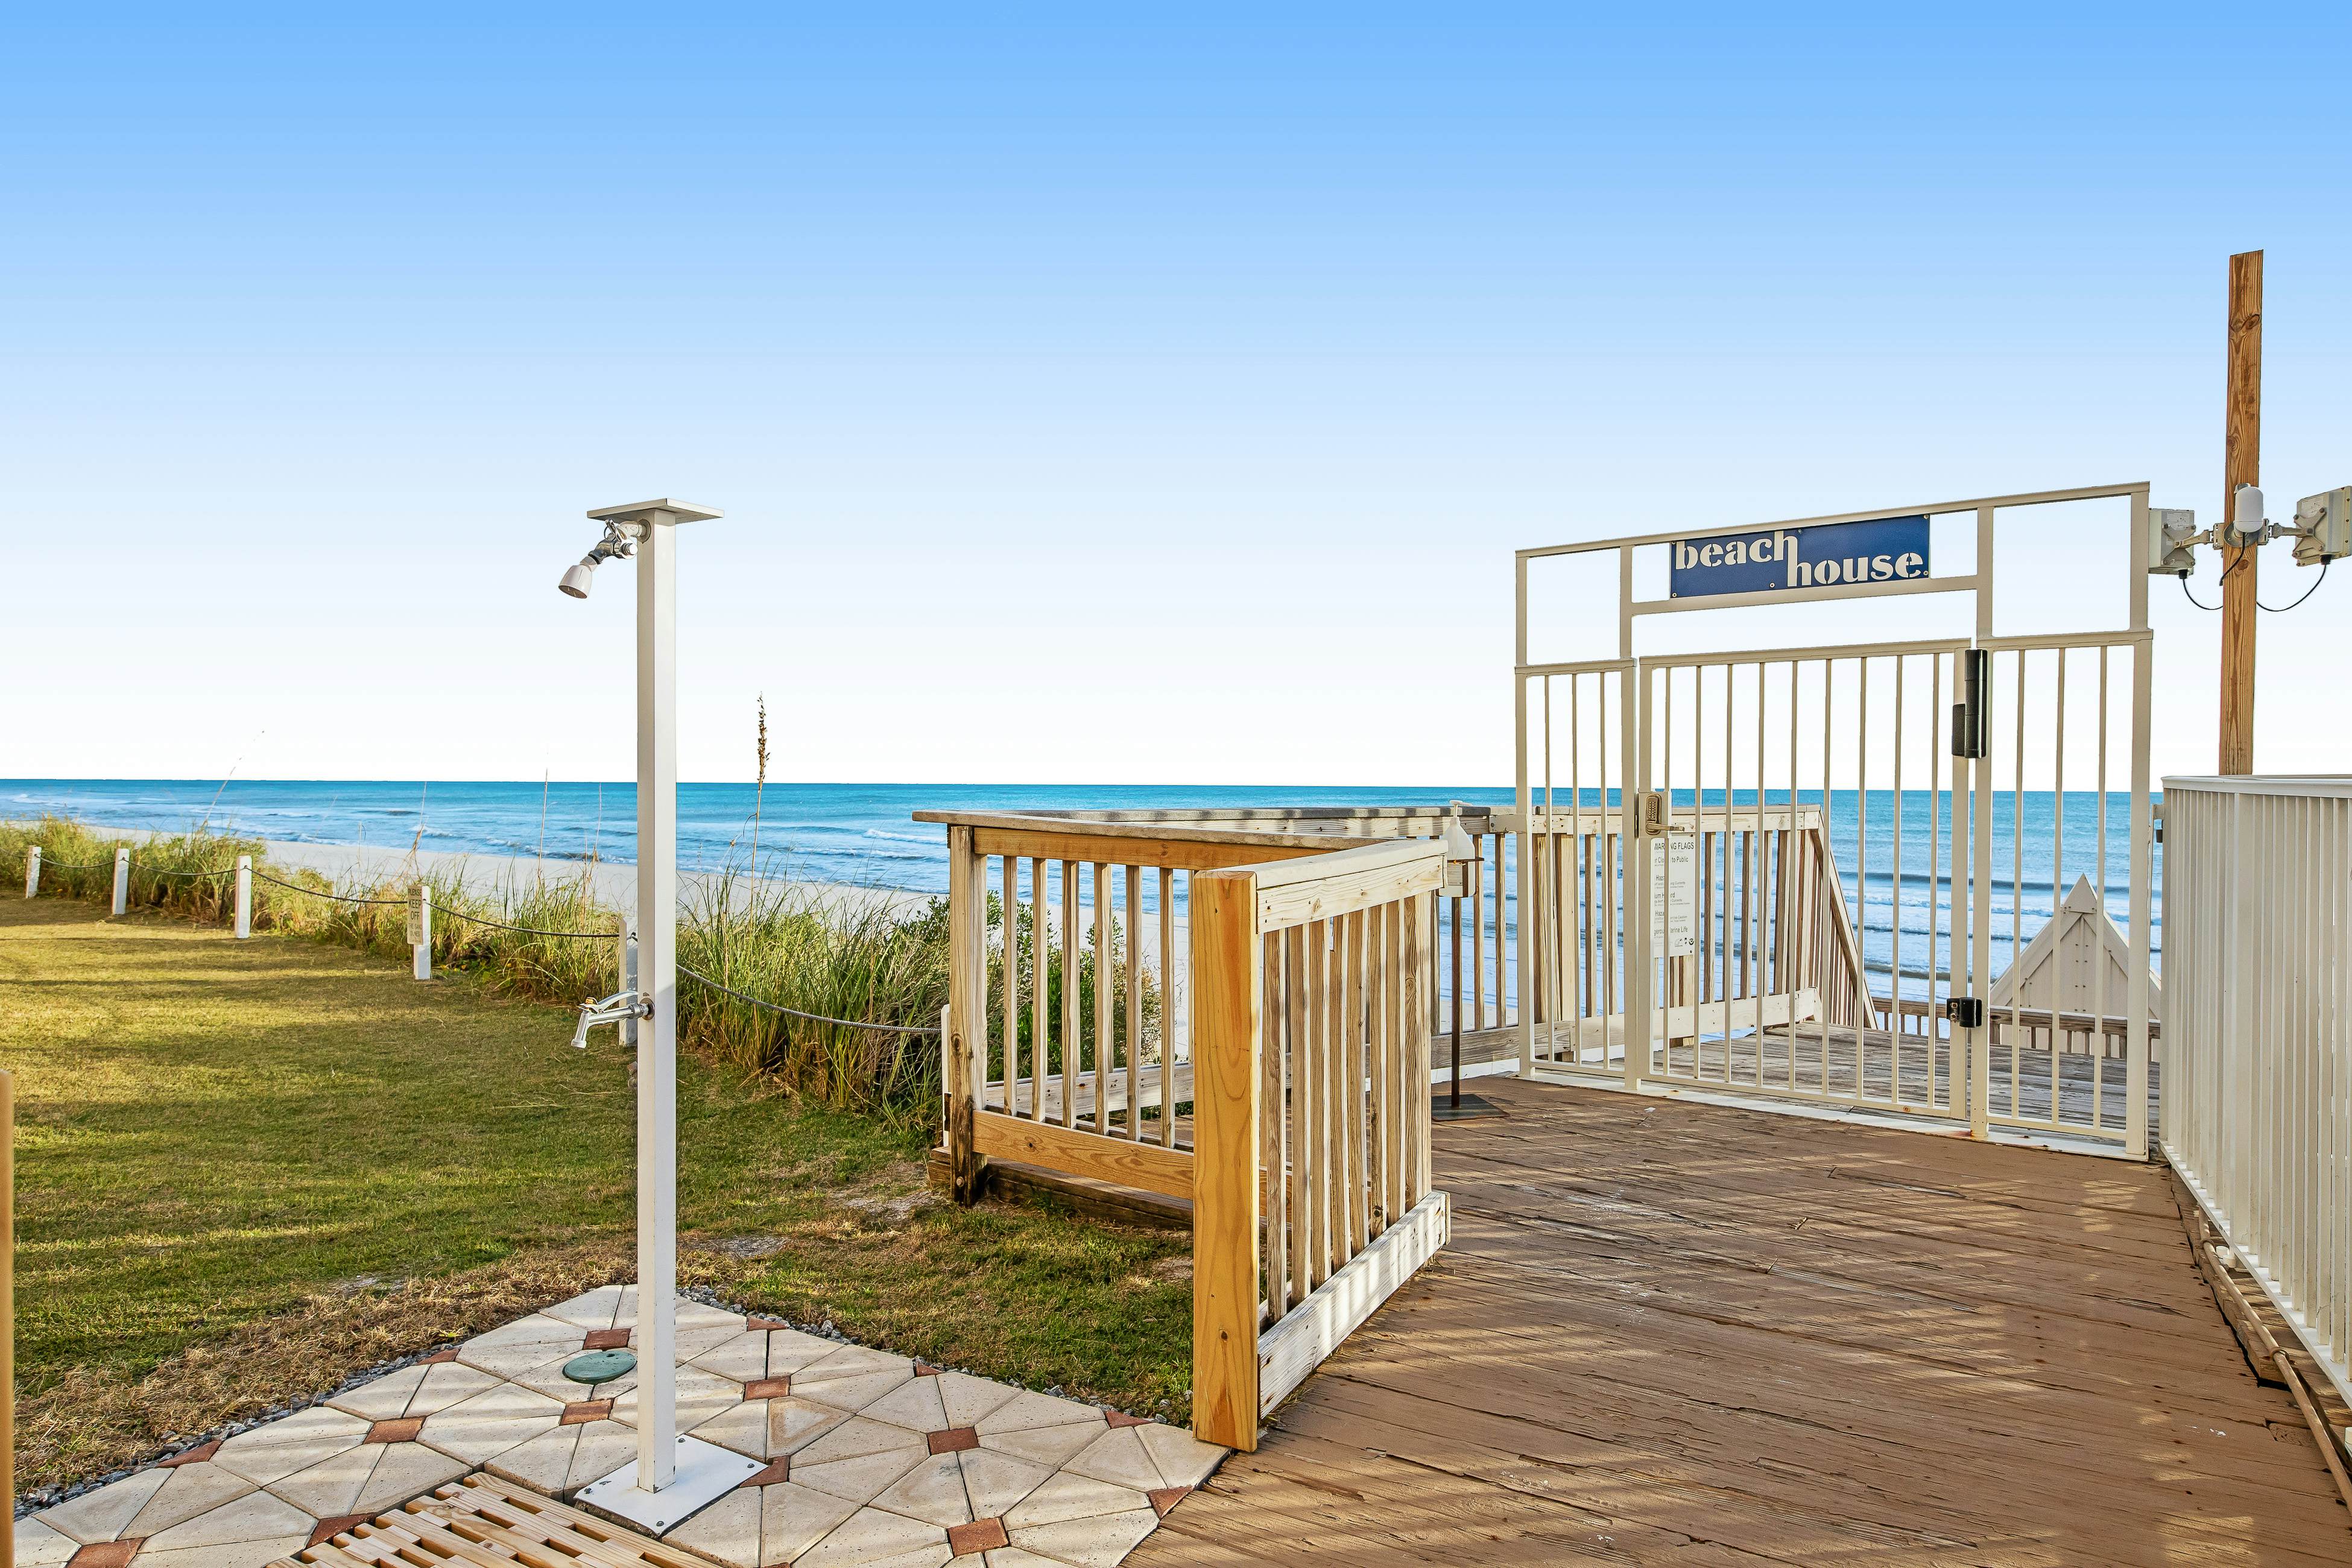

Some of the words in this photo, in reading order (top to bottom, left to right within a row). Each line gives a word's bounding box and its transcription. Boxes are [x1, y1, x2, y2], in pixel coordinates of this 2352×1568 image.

[1676, 531, 1797, 570] beach
[1787, 538, 1923, 587] house
[408, 888, 422, 897] PLEASE
[409, 899, 422, 909] KEEP
[411, 911, 420, 920] OFF
